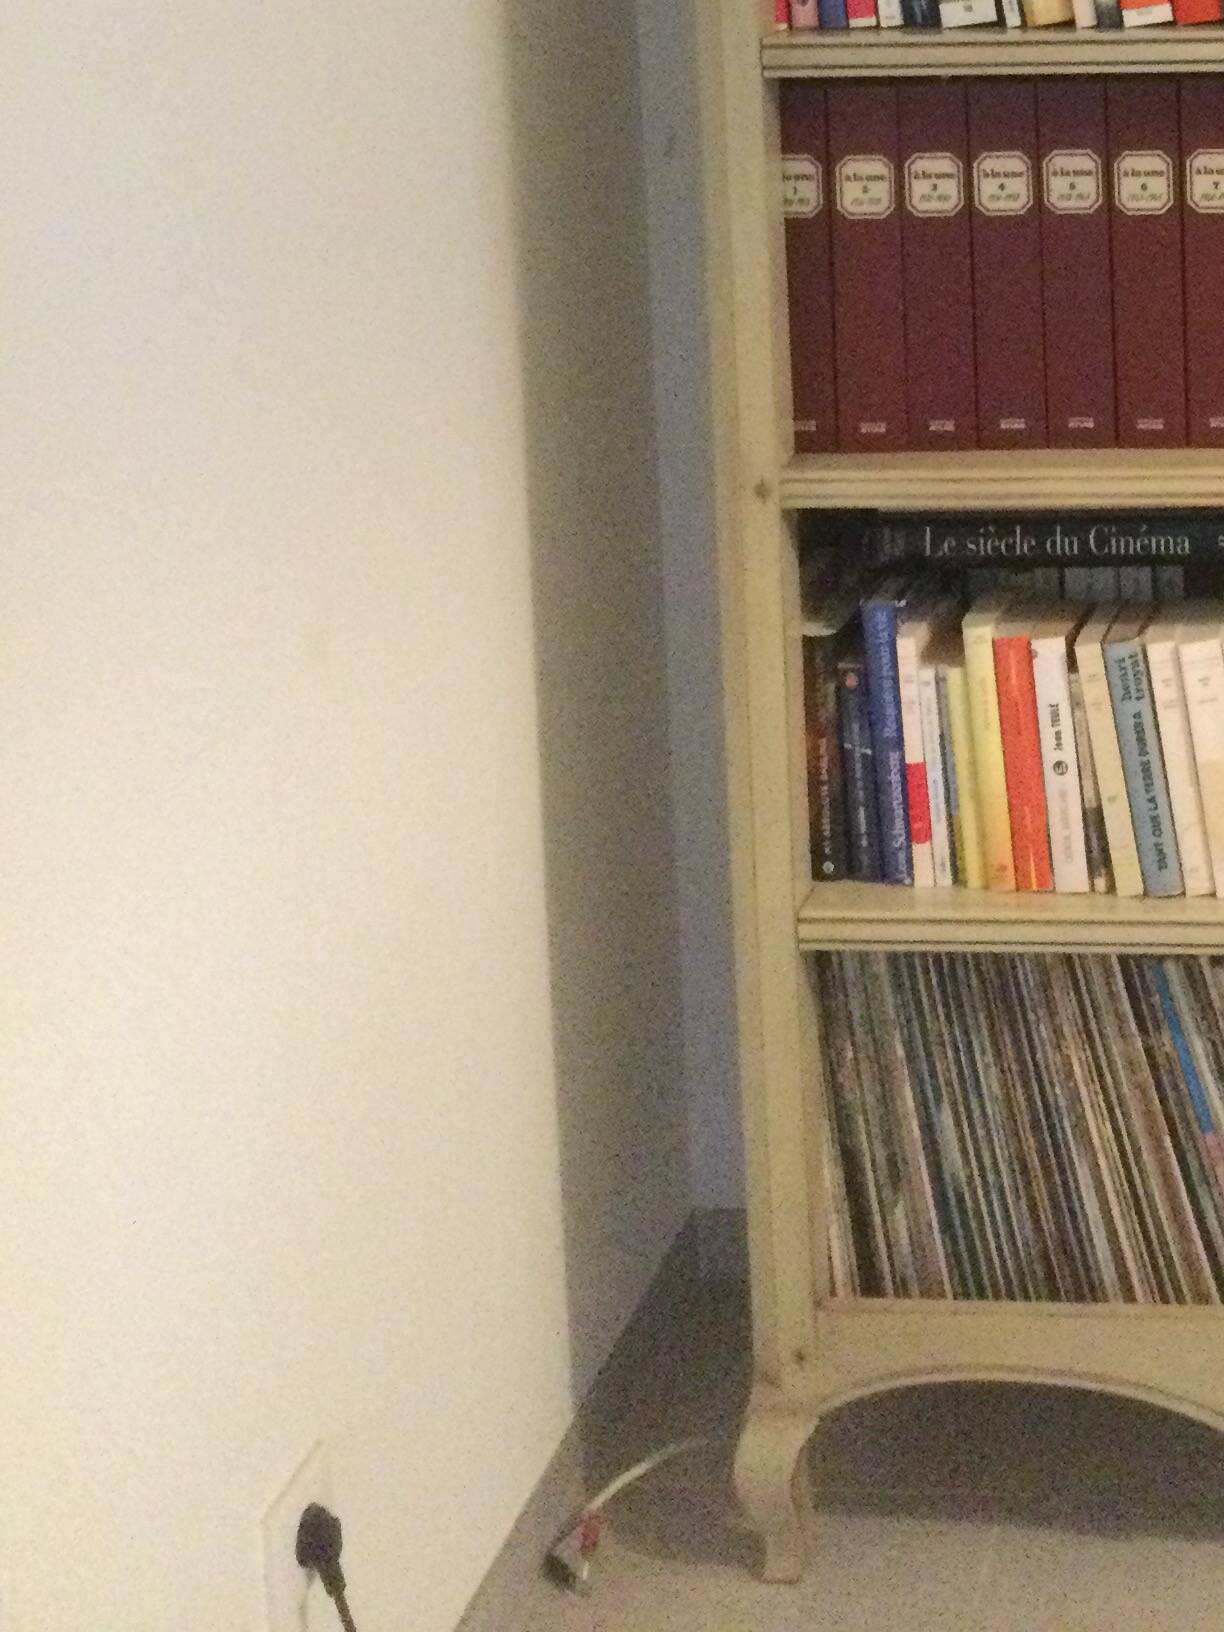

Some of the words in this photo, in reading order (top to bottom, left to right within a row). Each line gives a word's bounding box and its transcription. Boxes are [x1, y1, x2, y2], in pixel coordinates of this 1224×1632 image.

[924, 527, 958, 557] Le
[966, 525, 1037, 556] siècle
[1045, 527, 1080, 556] du
[1088, 524, 1192, 556] Cinéma
[1114, 657, 1132, 702] henri
[1127, 652, 1146, 701] troyat
[1052, 730, 1064, 752] Jean
[1131, 710, 1149, 757] DURERA
[1139, 759, 1155, 795] TERRE
[1145, 795, 1159, 811] LA
[1148, 812, 1164, 837] QUE
[1152, 841, 1169, 872] TANT
